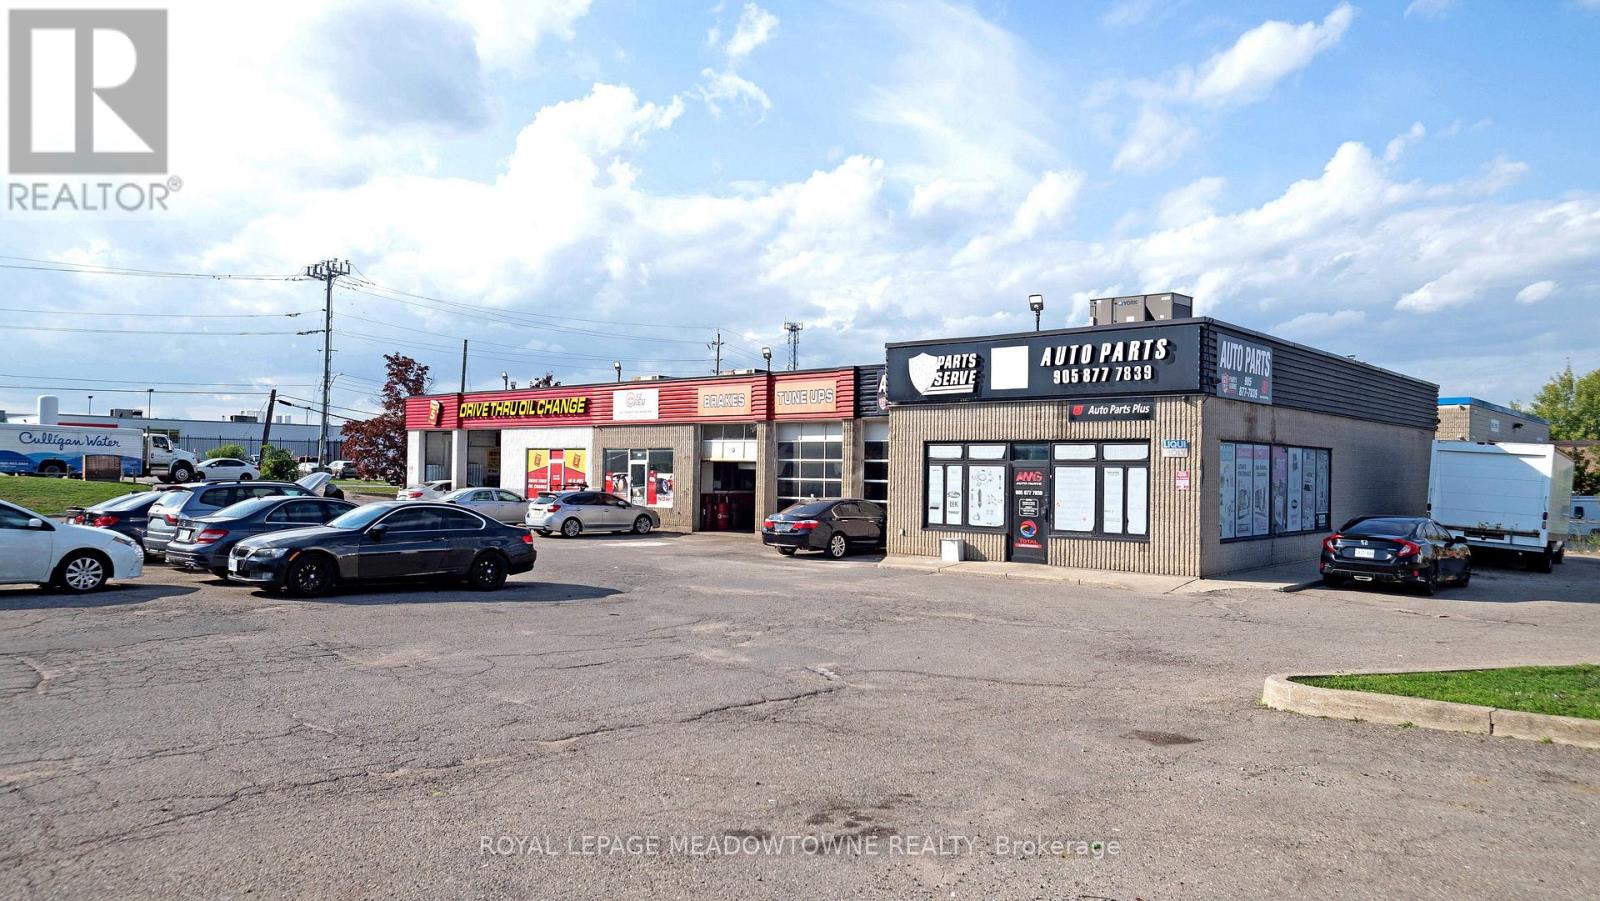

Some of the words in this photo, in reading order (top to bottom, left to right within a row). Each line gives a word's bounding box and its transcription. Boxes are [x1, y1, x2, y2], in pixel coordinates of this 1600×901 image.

[1040, 344, 1092, 367] AUTO
[1099, 338, 1168, 363] PARTS
[1220, 340, 1243, 372] AUTO
[1244, 346, 1271, 377] PARTS
[936, 353, 977, 370] PARTS
[934, 370, 977, 386] SERVE
[1053, 368, 1079, 384] 905
[1082, 367, 1109, 383] 877
[1115, 365, 1152, 382] 7839
[703, 392, 745, 408] BRAKES
[777, 390, 807, 406] TUNE
[810, 388, 834, 404] UPS
[459, 402, 488, 418] DRIVE
[490, 400, 519, 417] THRU
[519, 399, 536, 416] OIL
[536, 397, 587, 415] CHANGE
[1088, 405, 1107, 416] Auto
[1109, 404, 1131, 415] Parts
[1132, 403, 1150, 414] Plus
[19, 431, 84, 450] Culligan
[85, 435, 120, 447] Water
[1163, 440, 1187, 448] LIQUI
[1016, 471, 1043, 482] AMG
